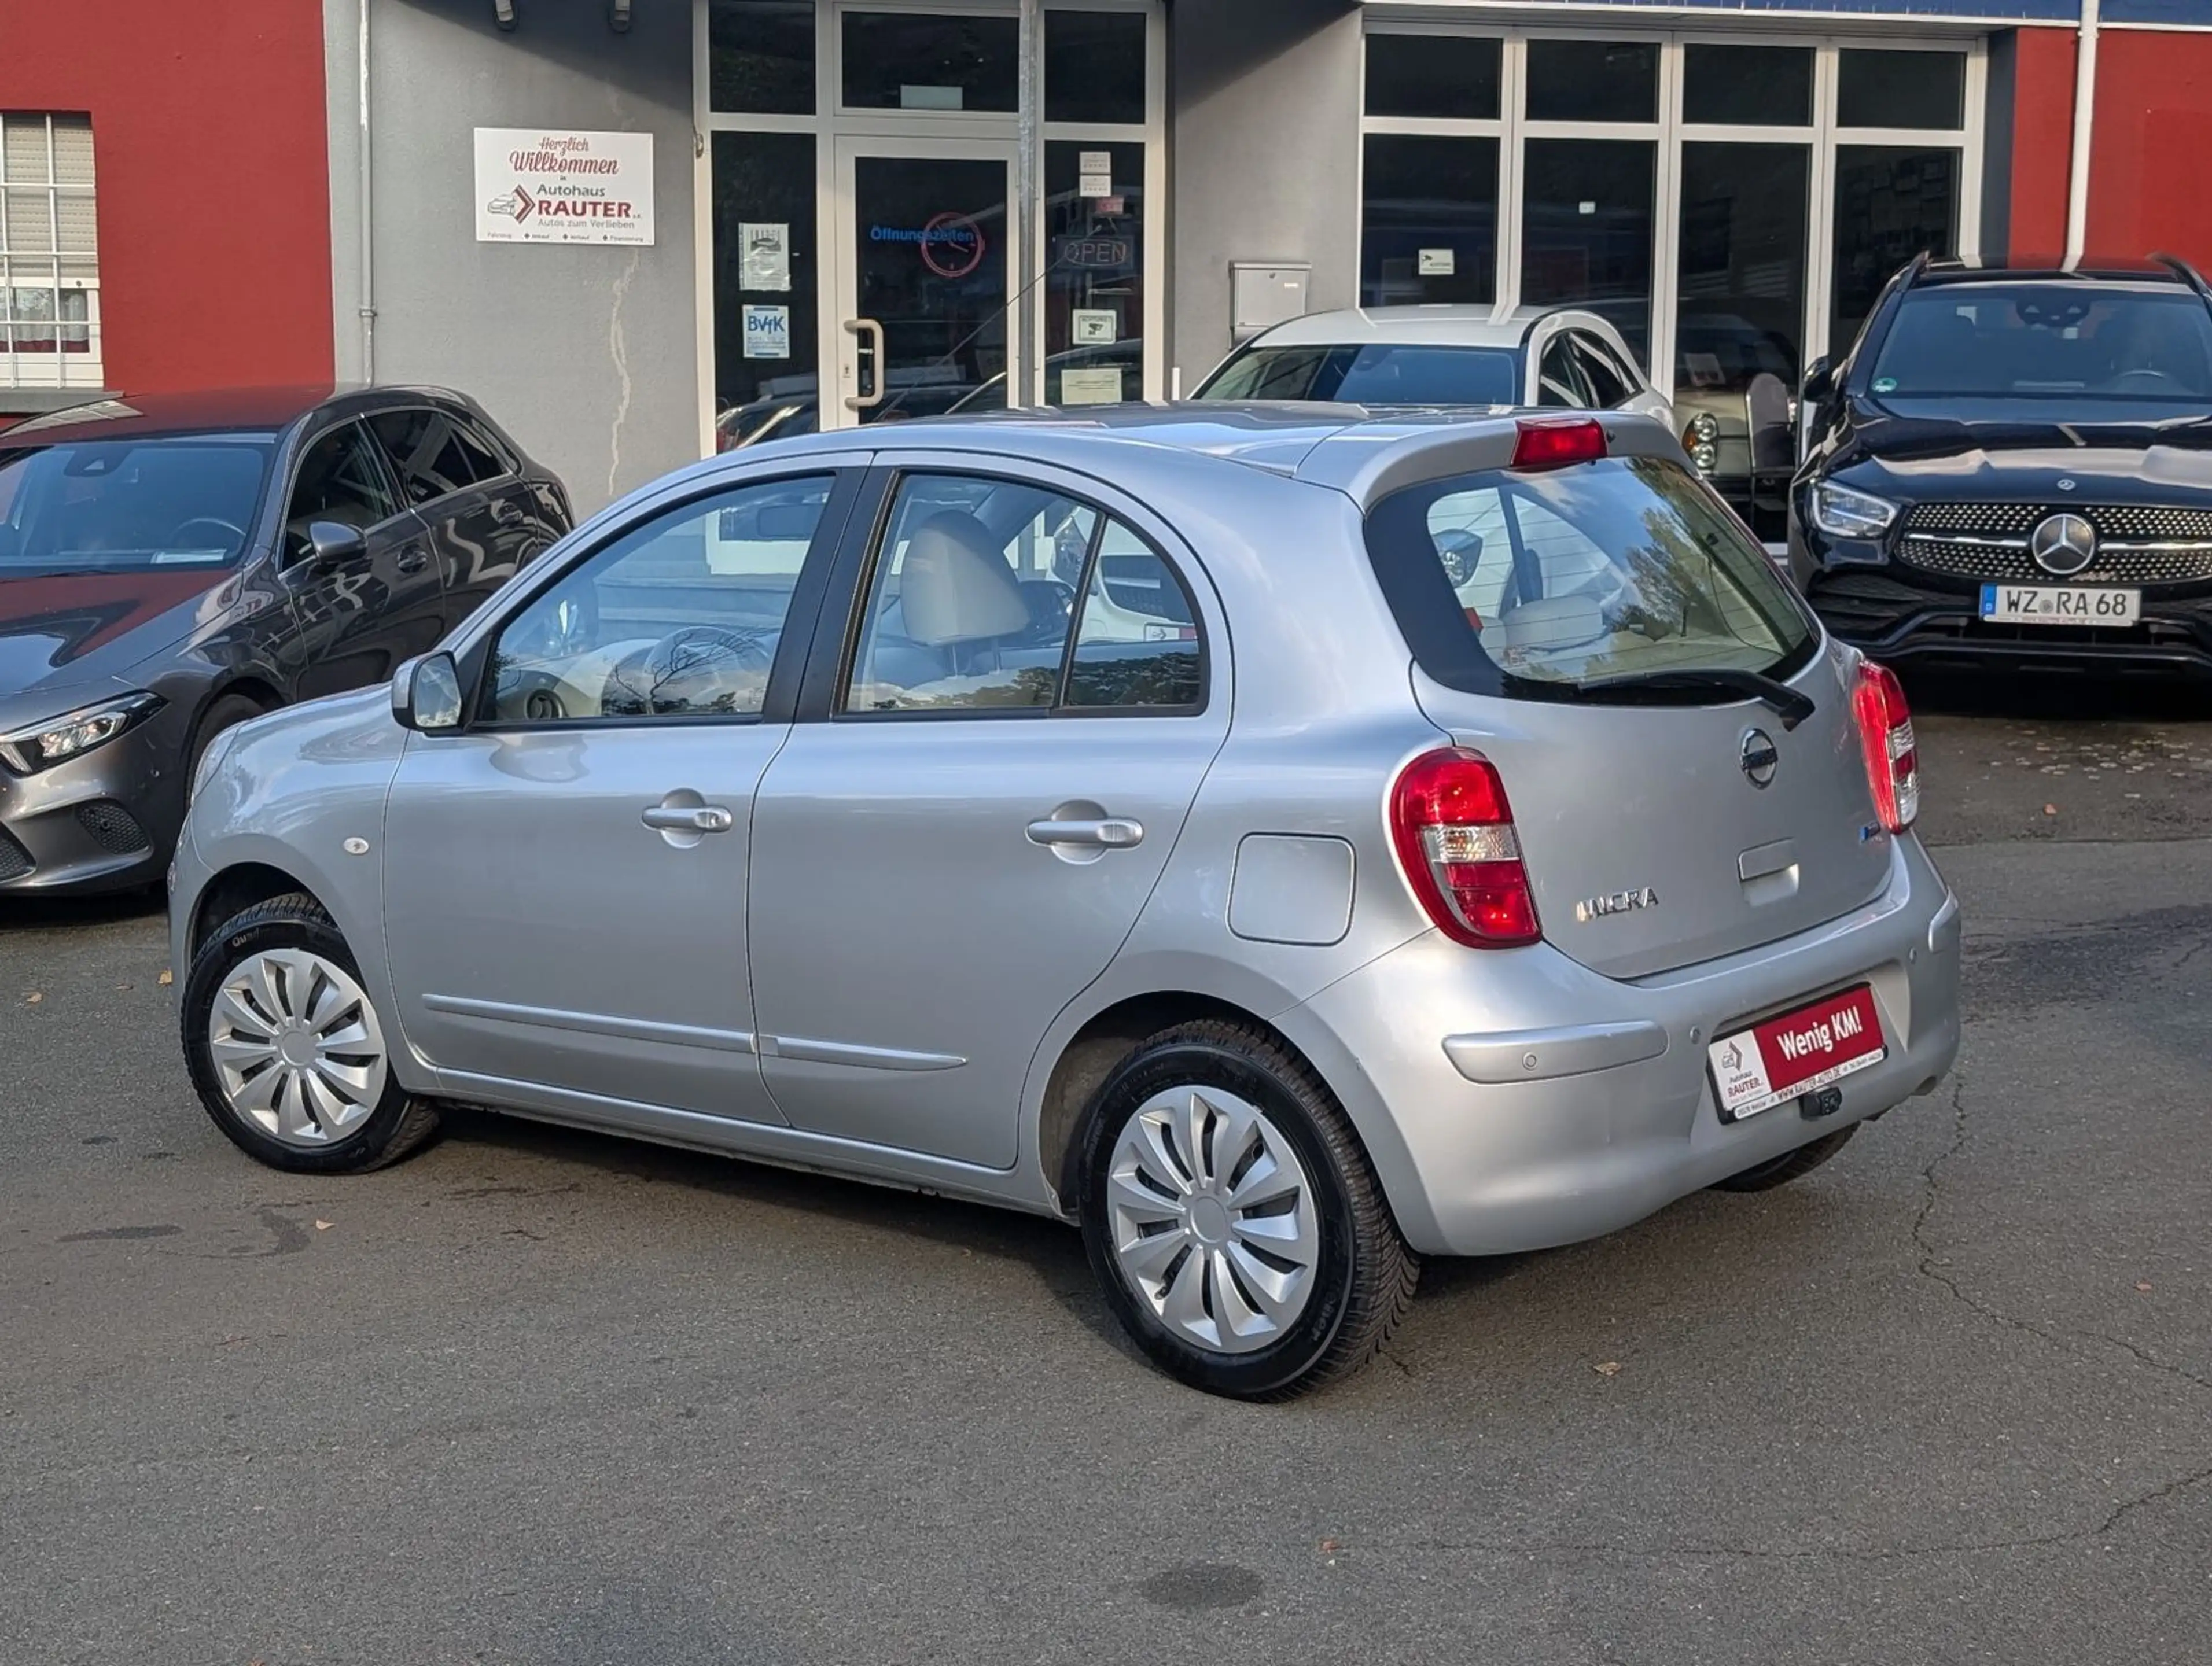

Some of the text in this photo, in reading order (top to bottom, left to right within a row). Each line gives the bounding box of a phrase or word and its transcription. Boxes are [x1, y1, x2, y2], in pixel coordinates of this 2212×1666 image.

[539, 137, 590, 155] Herzlich
[509, 151, 620, 174] Willkommen
[536, 184, 605, 197] Autohaus
[538, 200, 631, 218] RAUTER
[538, 219, 564, 228] Autos
[870, 224, 974, 244] Öffnungszeiten
[1065, 242, 1126, 263] OPEN
[2007, 591, 2127, 615] WZ RA 68
[1576, 886, 1659, 922] MICRA
[1777, 1021, 1833, 1061] Wenig
[1831, 1005, 1863, 1040] KM!
[1727, 1077, 1760, 1098] RAUTER
